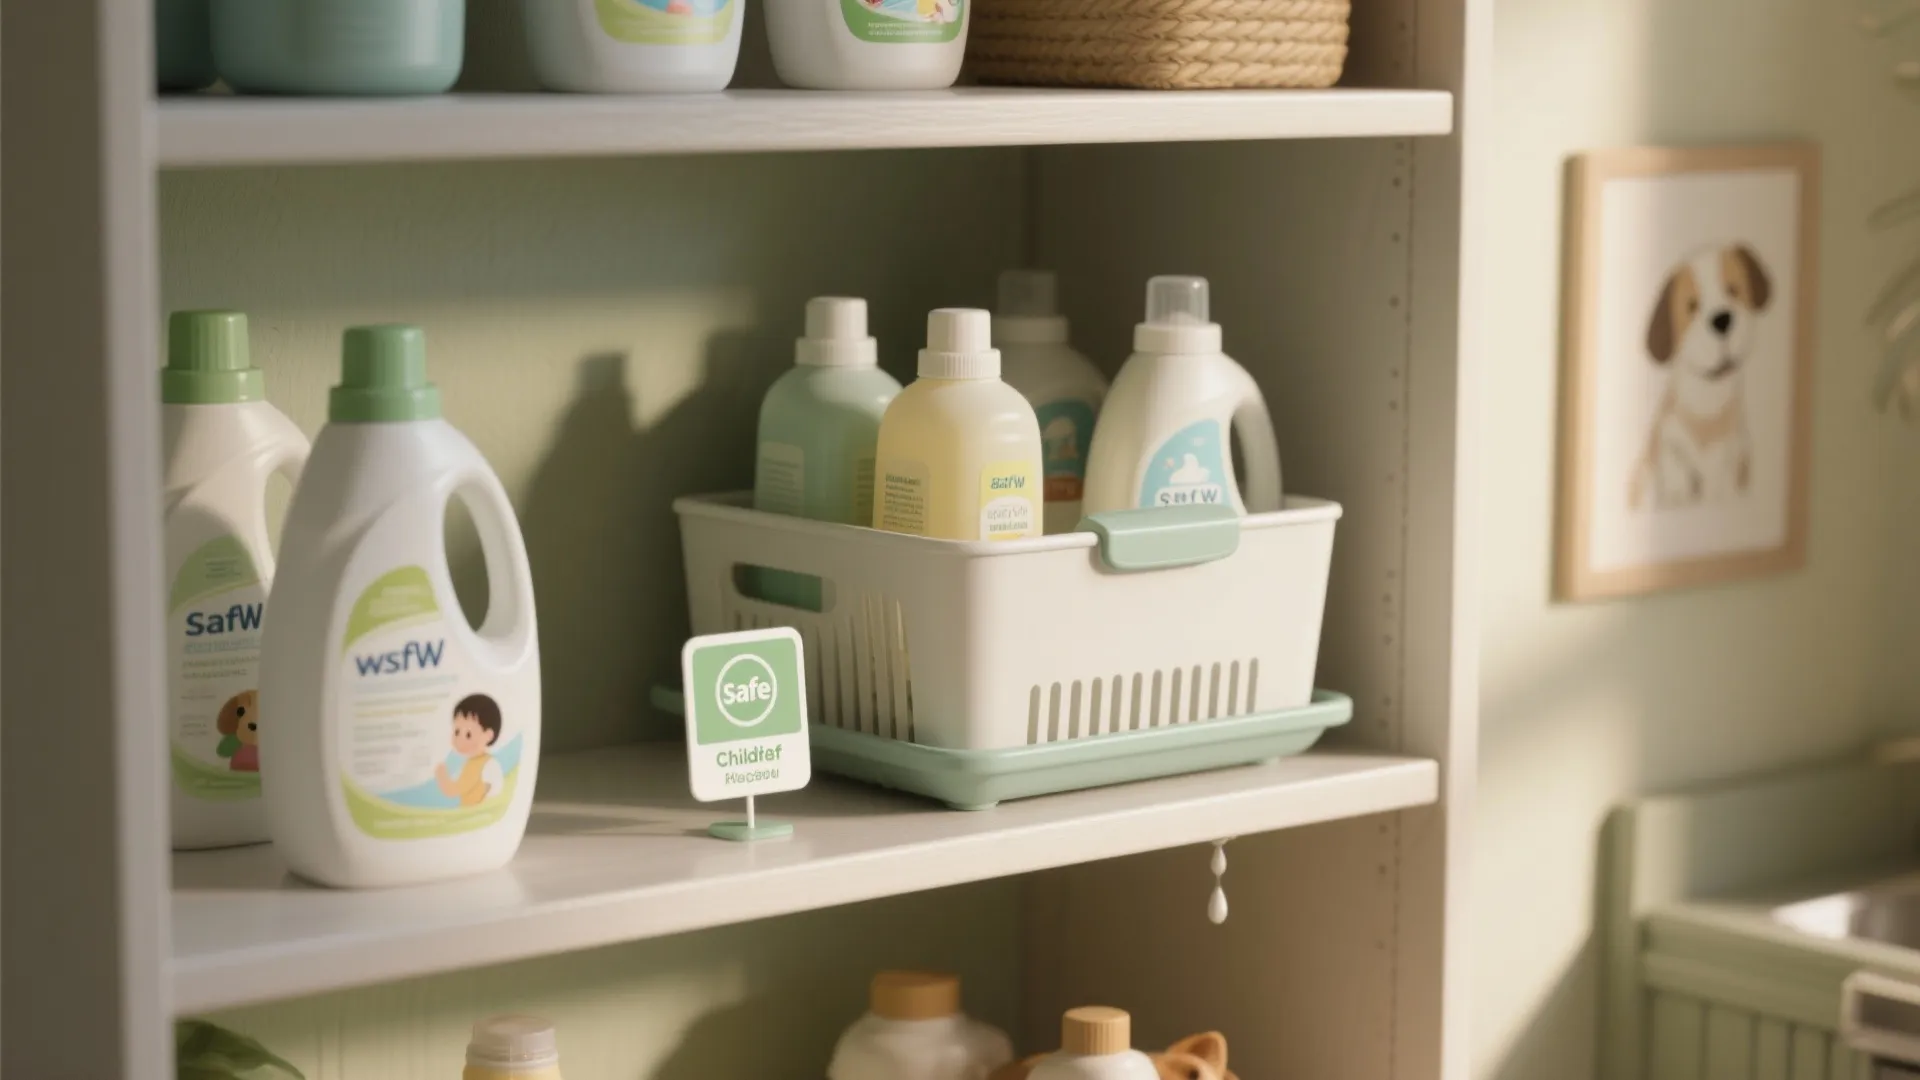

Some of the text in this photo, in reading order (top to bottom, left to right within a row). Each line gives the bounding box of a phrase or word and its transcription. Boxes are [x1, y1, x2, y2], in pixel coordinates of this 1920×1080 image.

[185, 602, 263, 637] SafW
[355, 639, 445, 677] wsfW
[722, 675, 772, 705] Safe
